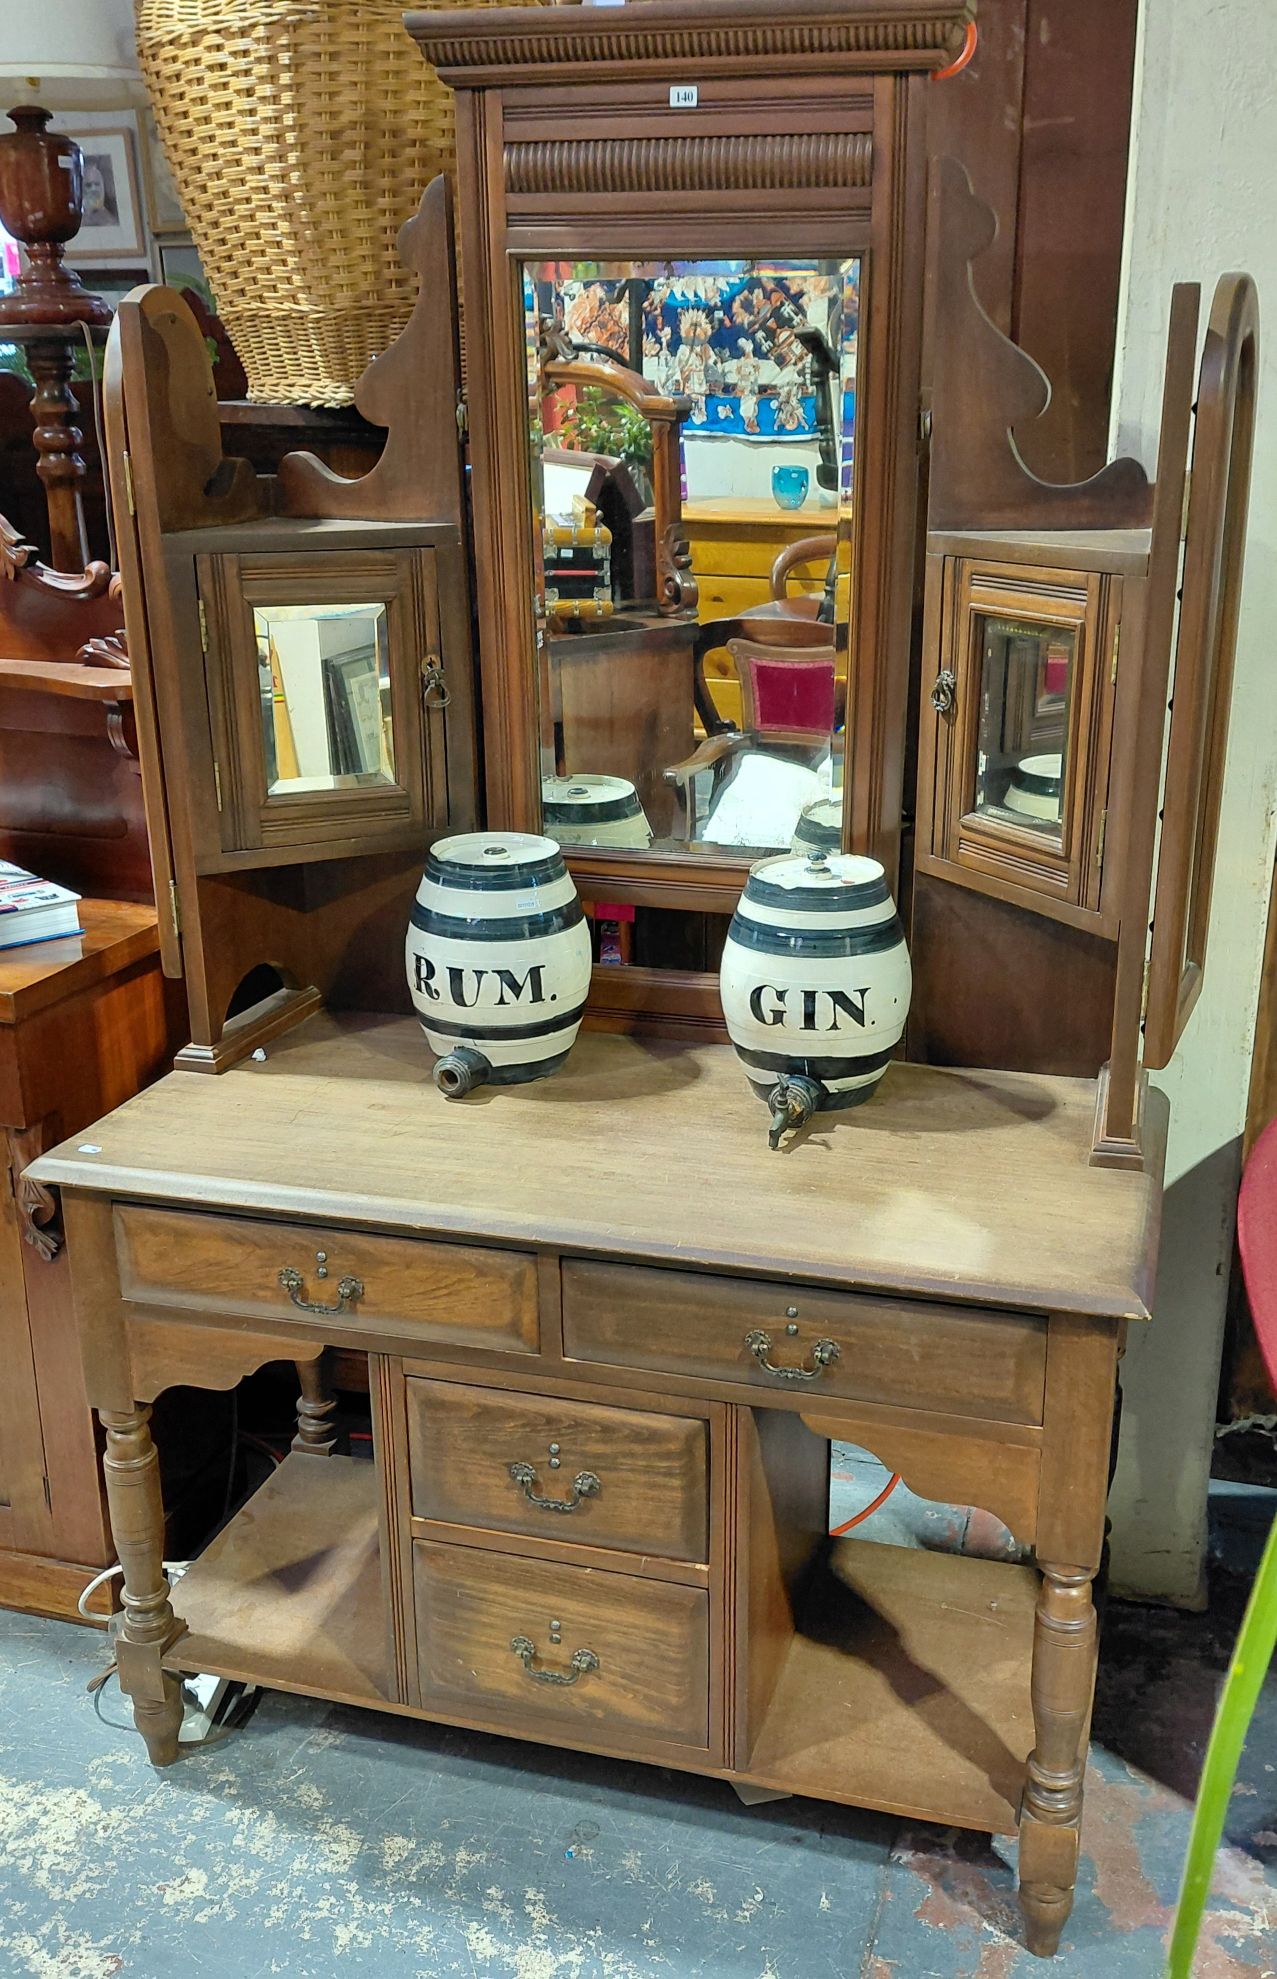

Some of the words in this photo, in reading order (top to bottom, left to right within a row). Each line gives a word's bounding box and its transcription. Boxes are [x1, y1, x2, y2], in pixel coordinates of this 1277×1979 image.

[677, 91, 694, 103] 140
[413, 952, 557, 1008] RUM.
[750, 984, 876, 1031] GIN.
